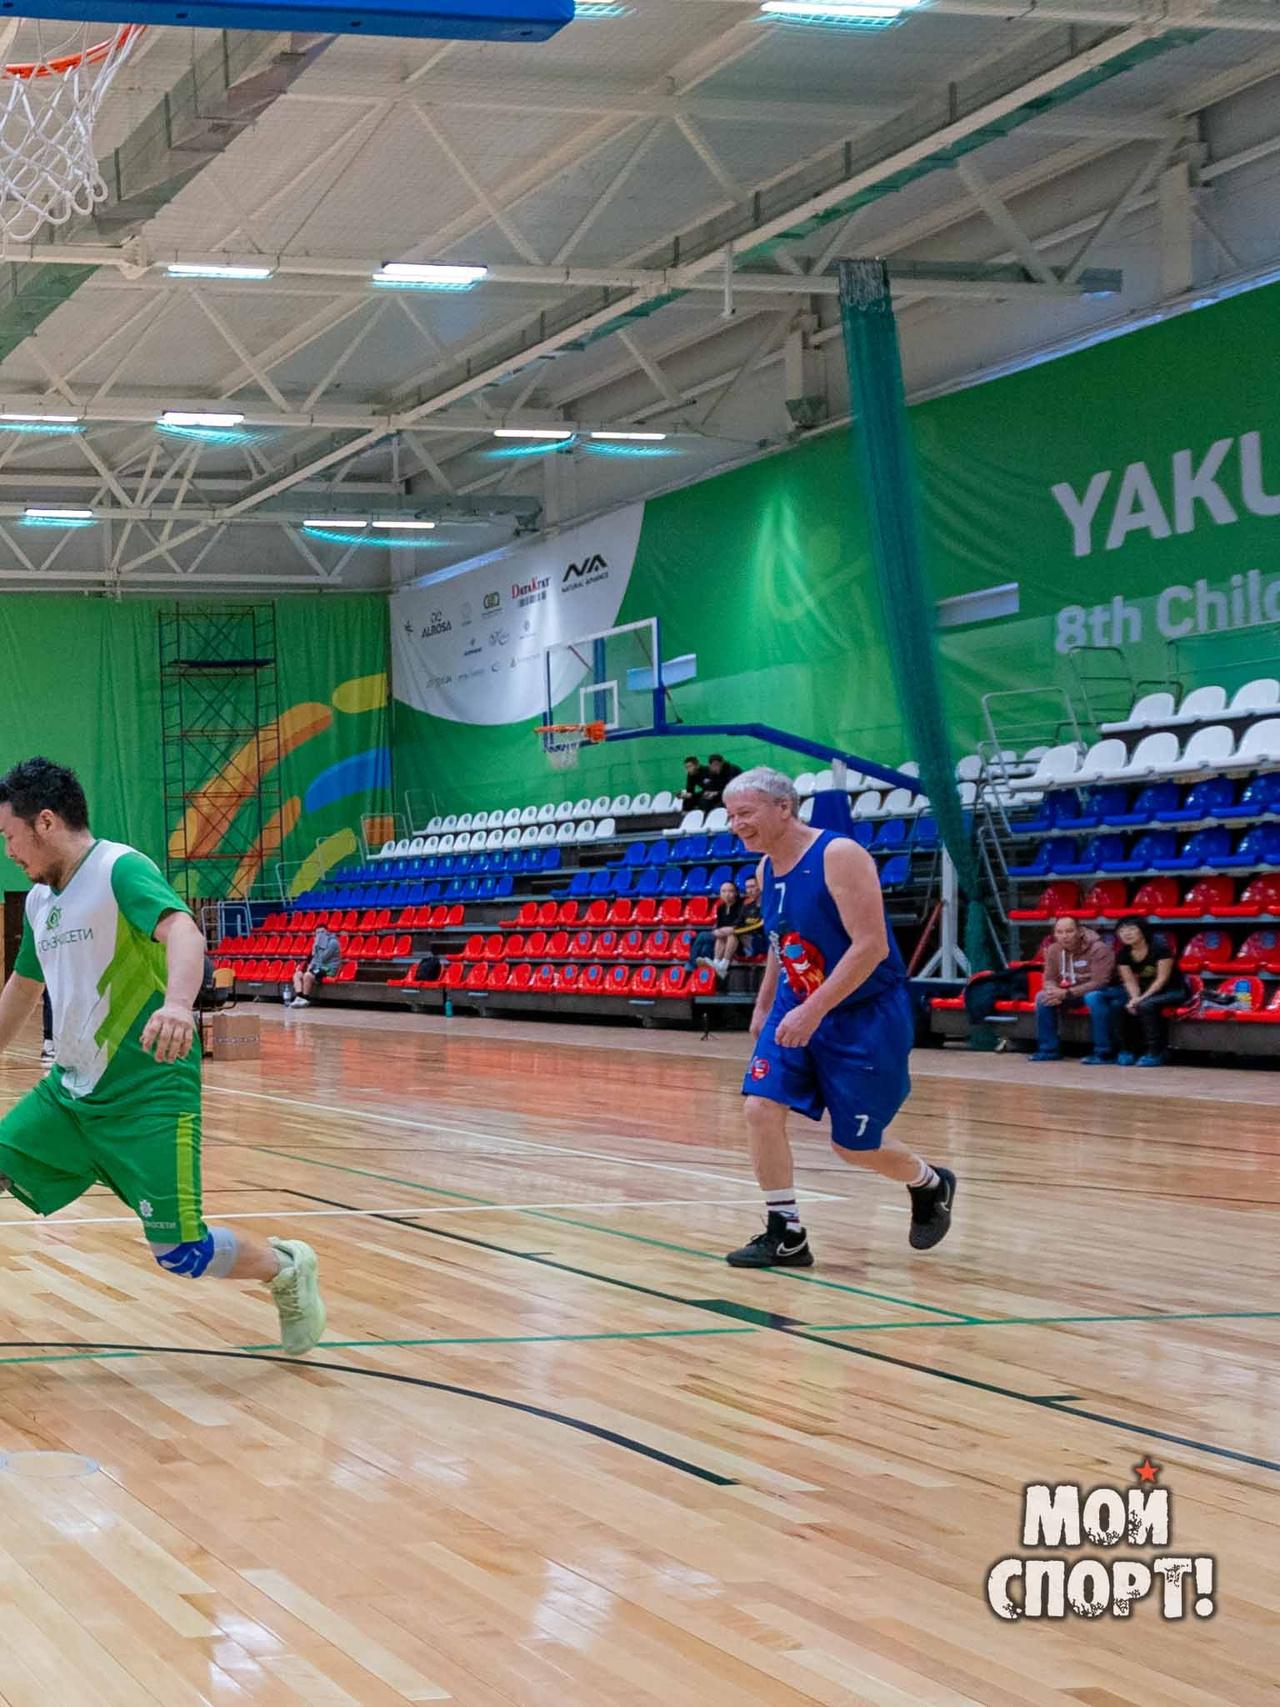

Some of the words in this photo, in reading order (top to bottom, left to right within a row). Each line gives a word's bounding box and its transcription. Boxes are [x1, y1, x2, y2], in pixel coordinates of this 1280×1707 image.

[422, 621, 452, 639] ALROSA
[1054, 595, 1142, 654] 8th
[774, 882, 786, 914] 7
[854, 1114, 869, 1137] 7
